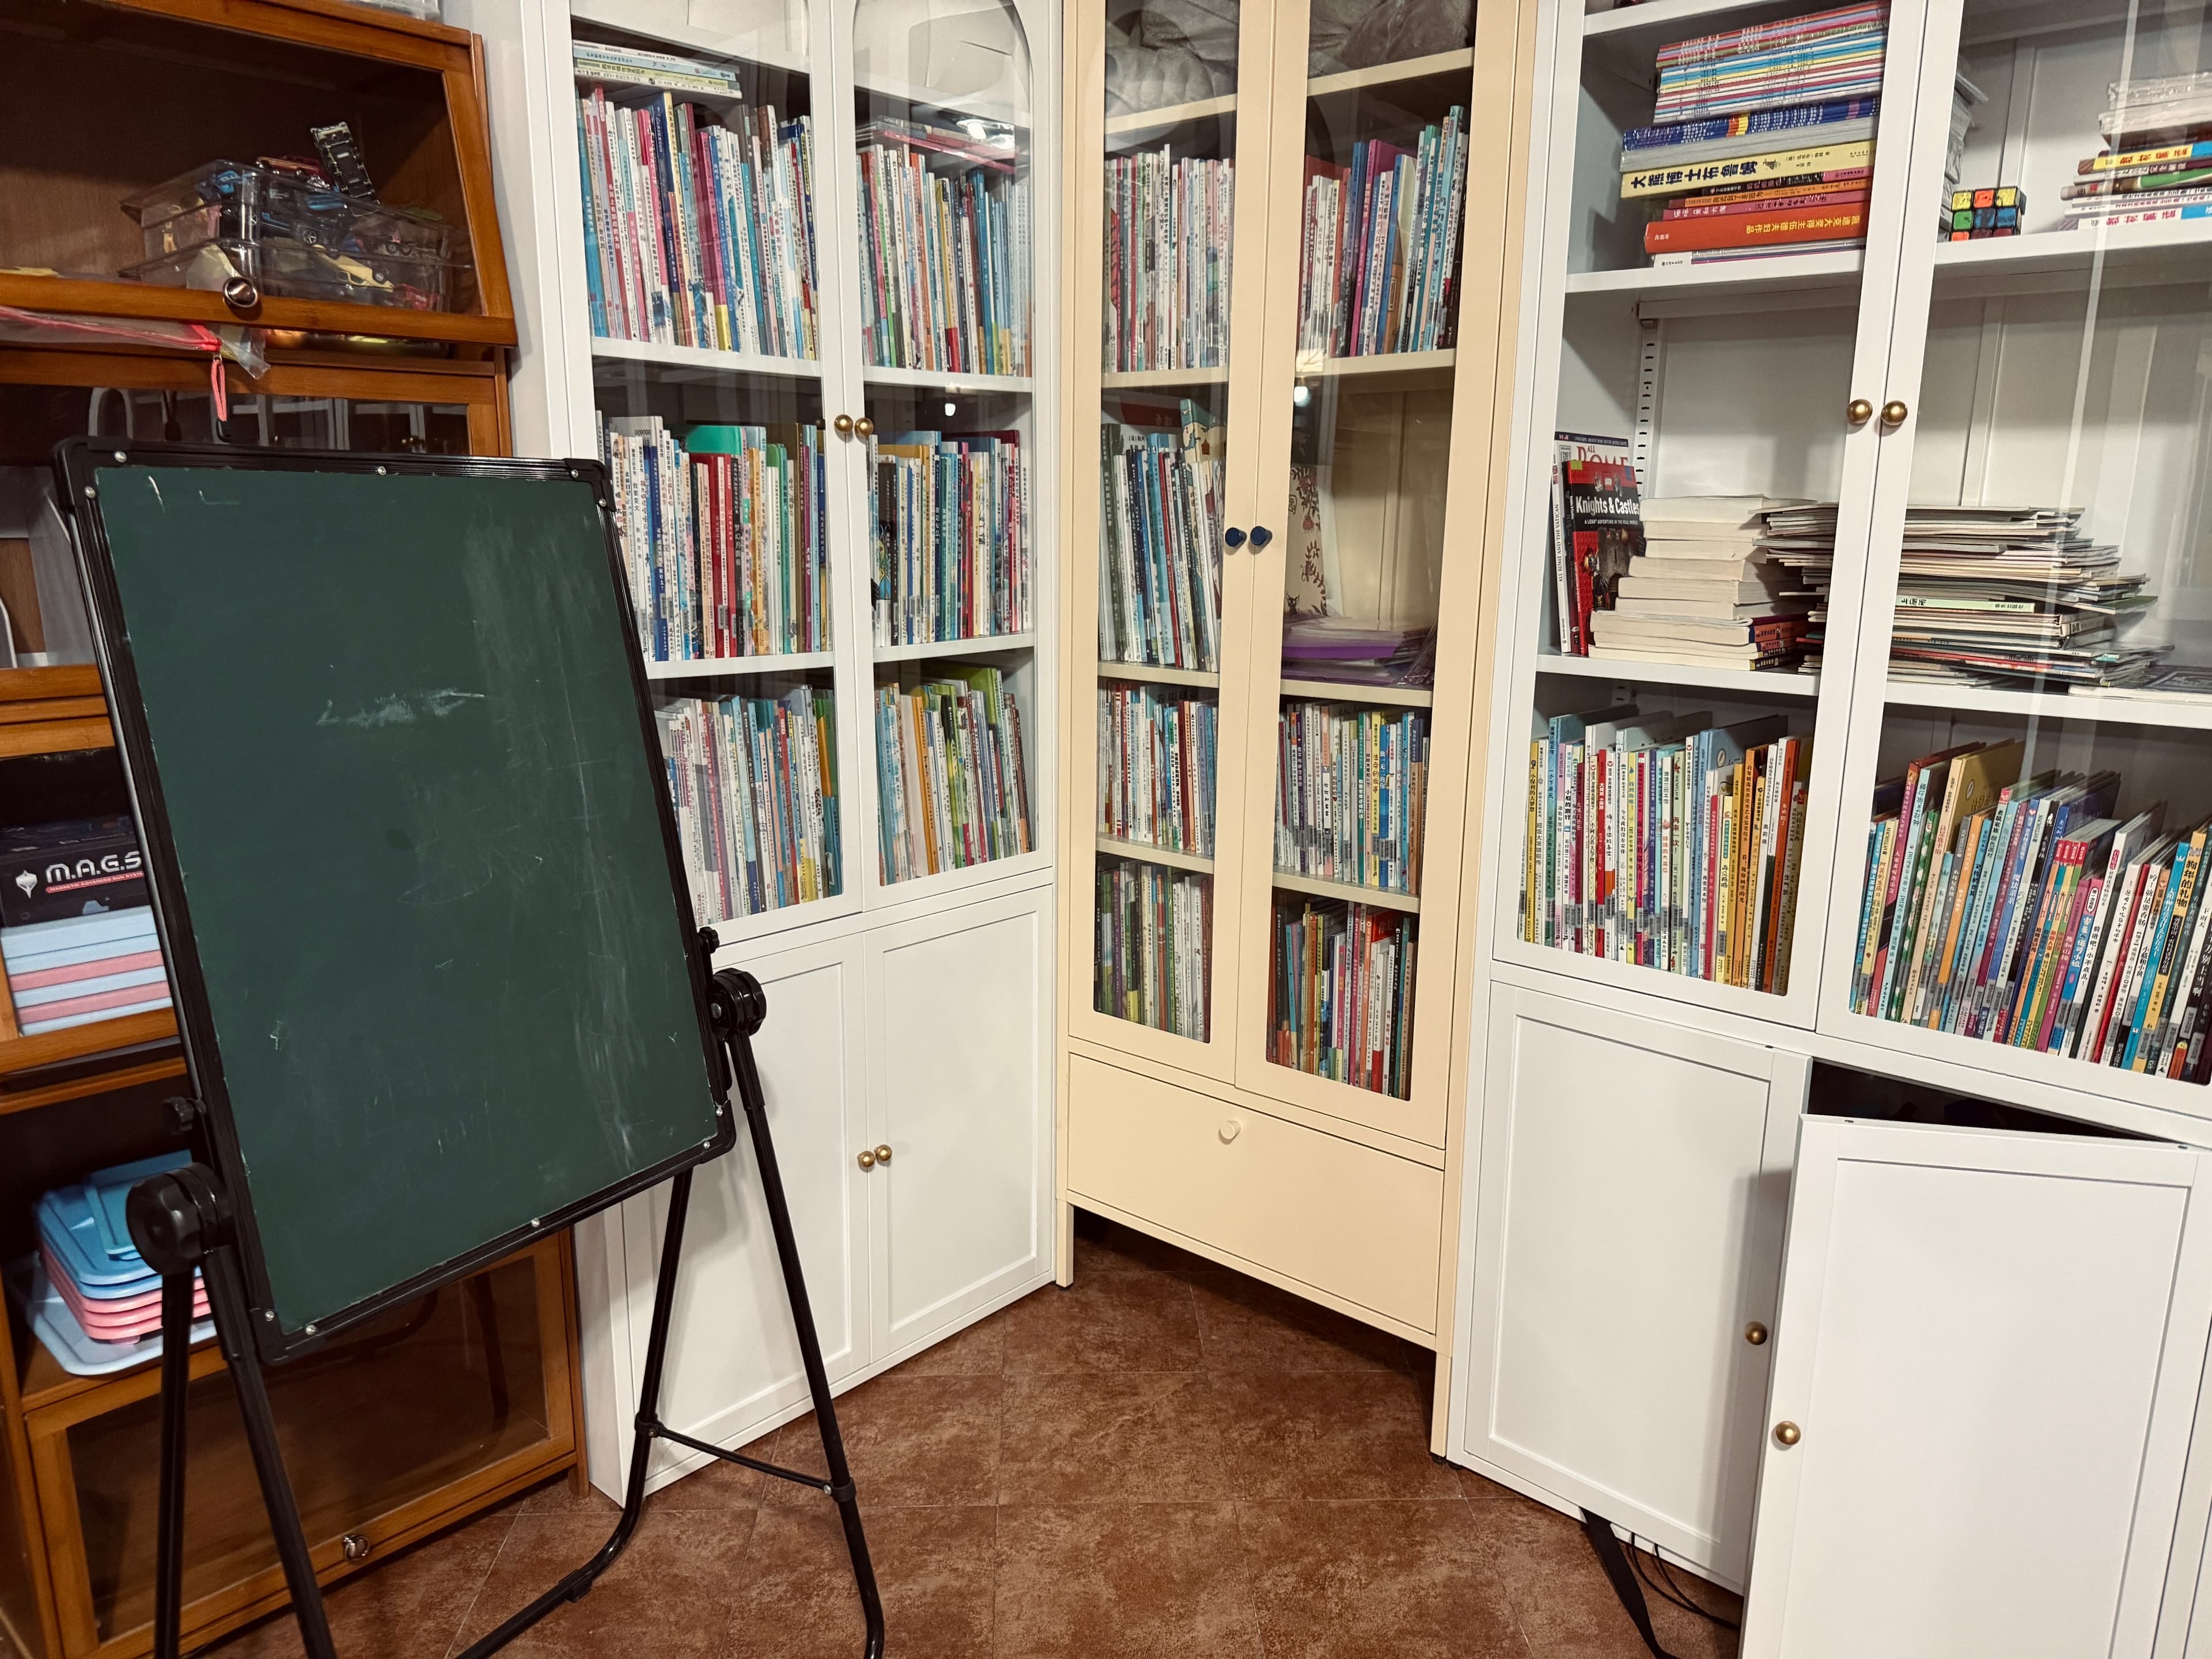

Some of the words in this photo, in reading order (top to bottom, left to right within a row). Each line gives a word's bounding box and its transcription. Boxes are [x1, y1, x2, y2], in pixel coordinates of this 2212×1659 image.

[1631, 162, 1759, 189] 大熊博士布鲁姆
[1575, 496, 1607, 516] Knights
[1608, 497, 1614, 514] &
[1615, 498, 1639, 515] Castles
[1563, 789, 1572, 820] 小船的旅行
[1993, 810, 2003, 834] 老鼠家族
[81, 877, 112, 887] ADVANCED
[2177, 861, 2197, 907] 狗年的礼物
[2138, 874, 2157, 927] 哼！就是要香肠
[2199, 908, 2210, 927] 下雨天
[2081, 926, 2101, 987] 前进吧，小不点儿！
[2137, 946, 2149, 977] 小蓝和小黄
